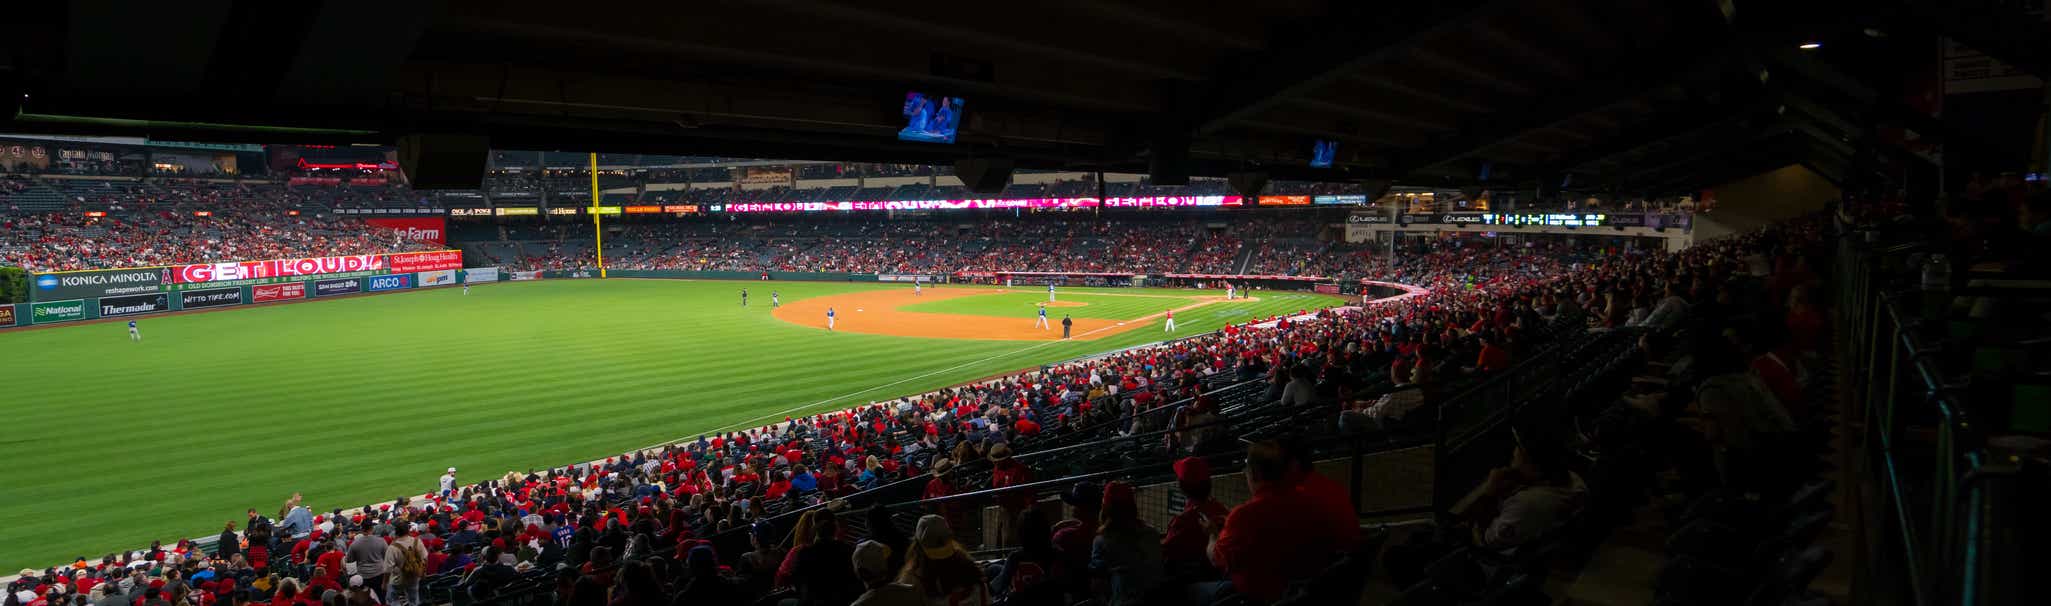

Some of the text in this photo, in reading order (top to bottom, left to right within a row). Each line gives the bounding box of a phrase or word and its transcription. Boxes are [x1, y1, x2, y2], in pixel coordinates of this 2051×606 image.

[407, 227, 440, 240] Farm
[182, 261, 264, 283] GET
[276, 255, 374, 276] LOUD!
[62, 272, 157, 287] KONICA MINOLTA
[372, 277, 399, 289] ARCO
[105, 285, 159, 295] reshapework.com
[184, 295, 206, 304] NITTO
[46, 304, 82, 315] National
[103, 303, 157, 315] Thermador
